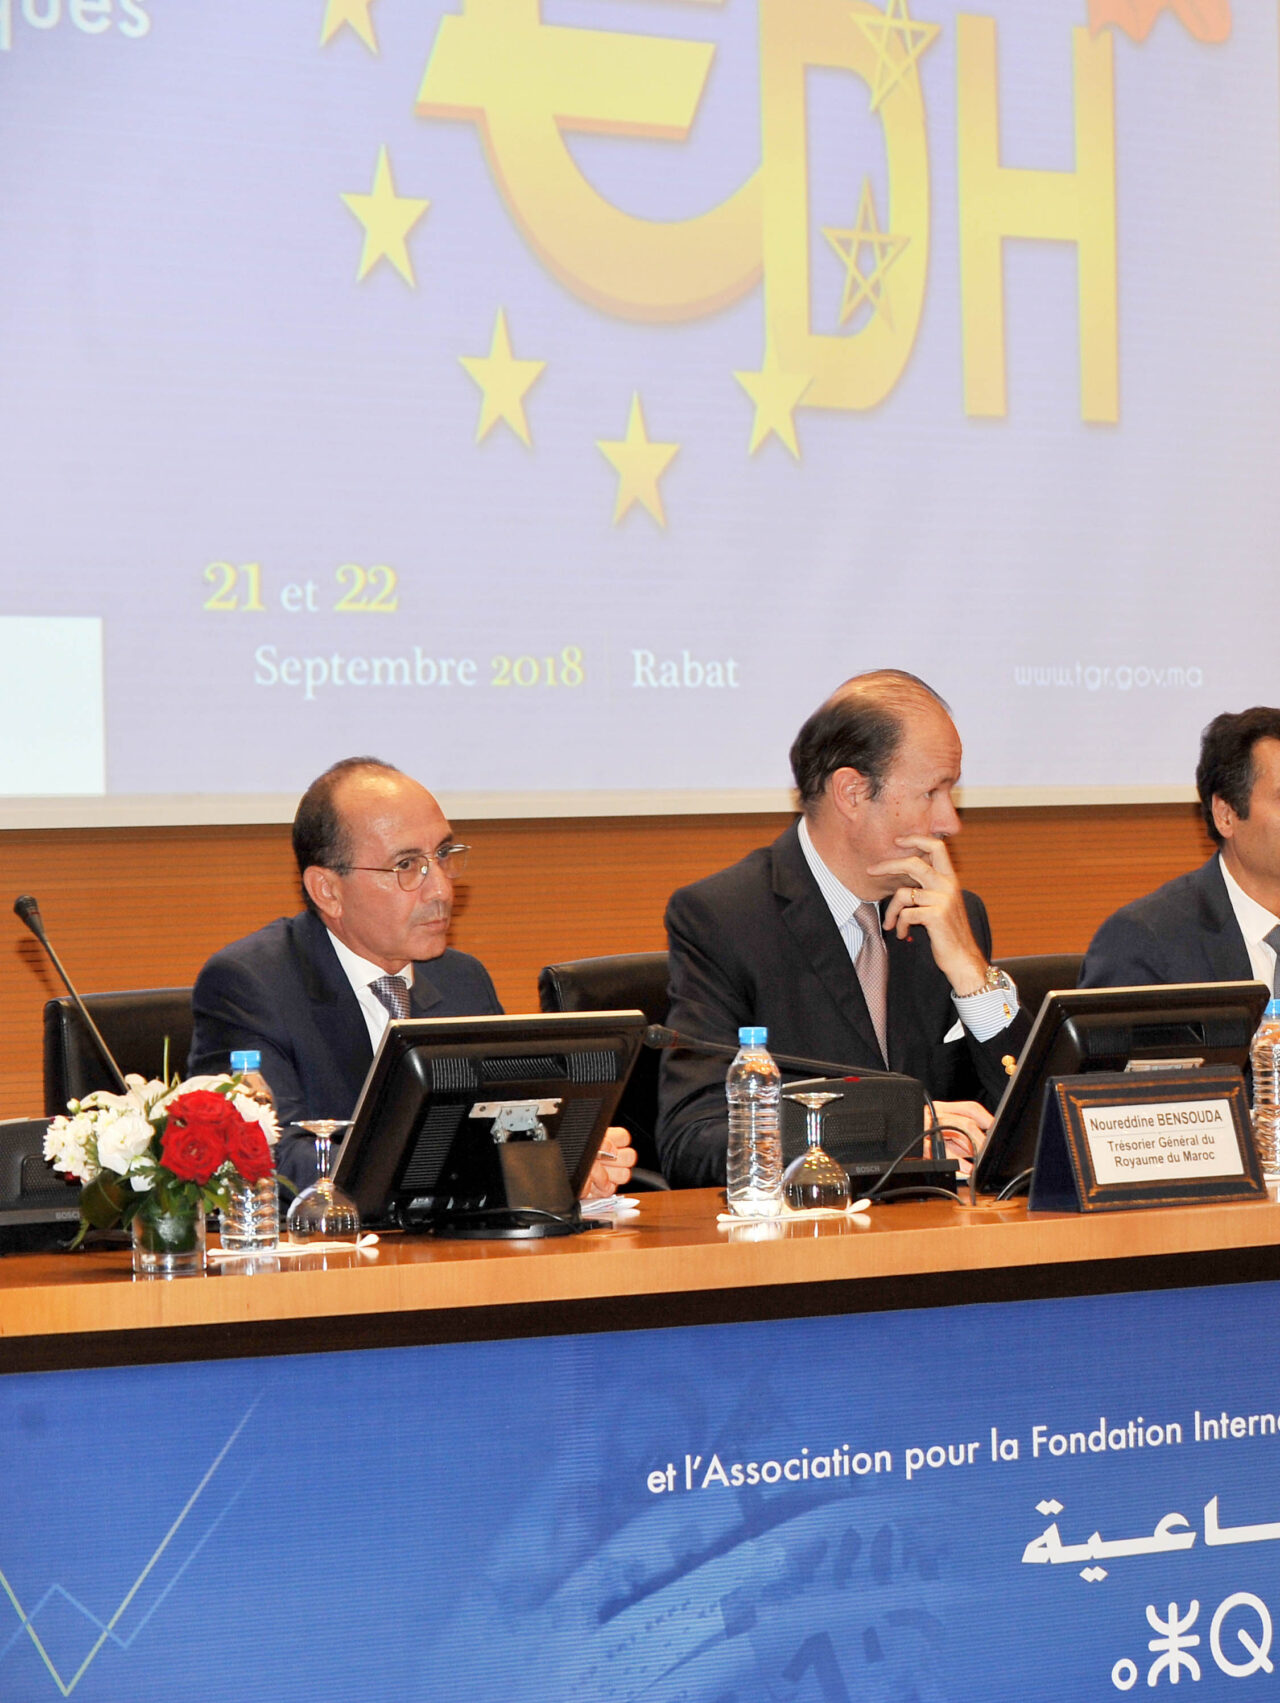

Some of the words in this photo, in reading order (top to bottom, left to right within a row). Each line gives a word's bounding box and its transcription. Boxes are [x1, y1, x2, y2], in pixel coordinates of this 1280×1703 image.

[202, 561, 268, 613] 21
[279, 579, 319, 613] et
[333, 563, 399, 613] 22
[254, 644, 479, 701] Septembre
[490, 647, 586, 688] 2018
[631, 647, 740, 689] Rabat
[1090, 1116, 1154, 1132] Noureddine
[1157, 1110, 1223, 1126] BENSOUDA
[1107, 1137, 1156, 1152] Trésorier
[1158, 1136, 1200, 1149] Général
[1202, 1134, 1216, 1146] du
[1114, 1154, 1164, 1169] Royaume
[1167, 1152, 1180, 1164] du
[1183, 1150, 1216, 1163] Maroc
[646, 1463, 677, 1494] et
[685, 1443, 893, 1490] l'Association
[904, 1441, 981, 1480] pour
[991, 1427, 1019, 1462] la
[1032, 1416, 1182, 1458] Fondation
